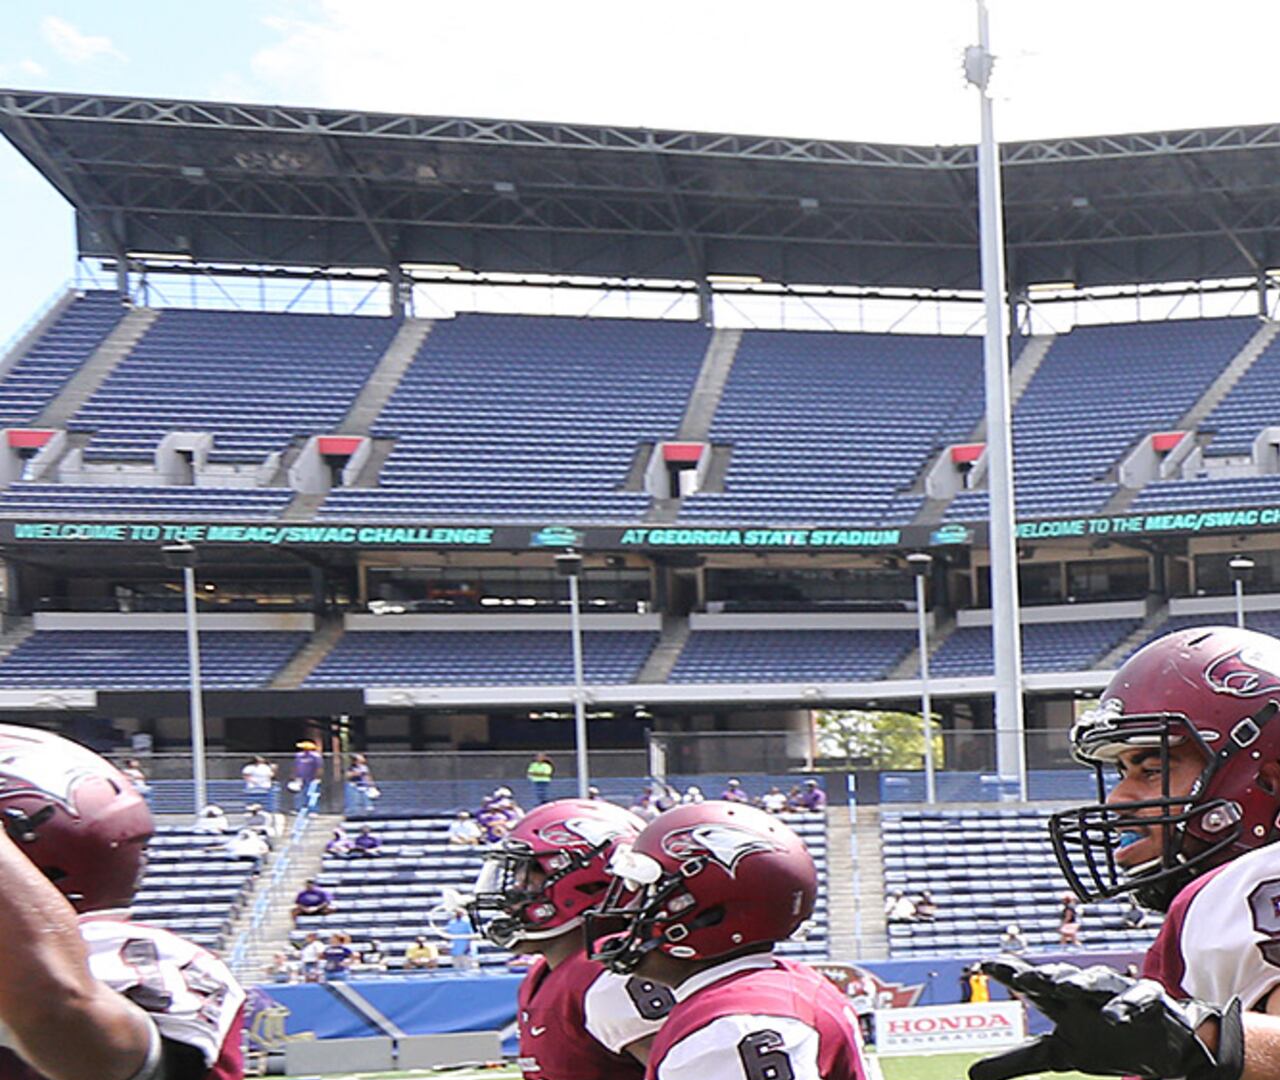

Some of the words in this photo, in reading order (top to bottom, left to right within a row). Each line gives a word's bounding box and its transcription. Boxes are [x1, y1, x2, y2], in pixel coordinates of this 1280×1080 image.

[1088, 517, 1111, 534] TO
[1112, 514, 1143, 533] THE
[1145, 505, 1260, 532] MEAC/SWAC
[14, 523, 127, 540] WELCOME
[130, 525, 159, 541] TO
[162, 525, 206, 542] THE
[206, 525, 356, 545] MEAC/SWAC
[358, 527, 495, 545] CHALLENGE
[620, 528, 648, 545] AT
[649, 529, 741, 546] GEORGIA
[743, 529, 808, 546] STATE
[809, 529, 901, 546] STADIUM
[886, 1012, 1010, 1036] HONDA
[887, 1030, 1014, 1044] GENERATORS
